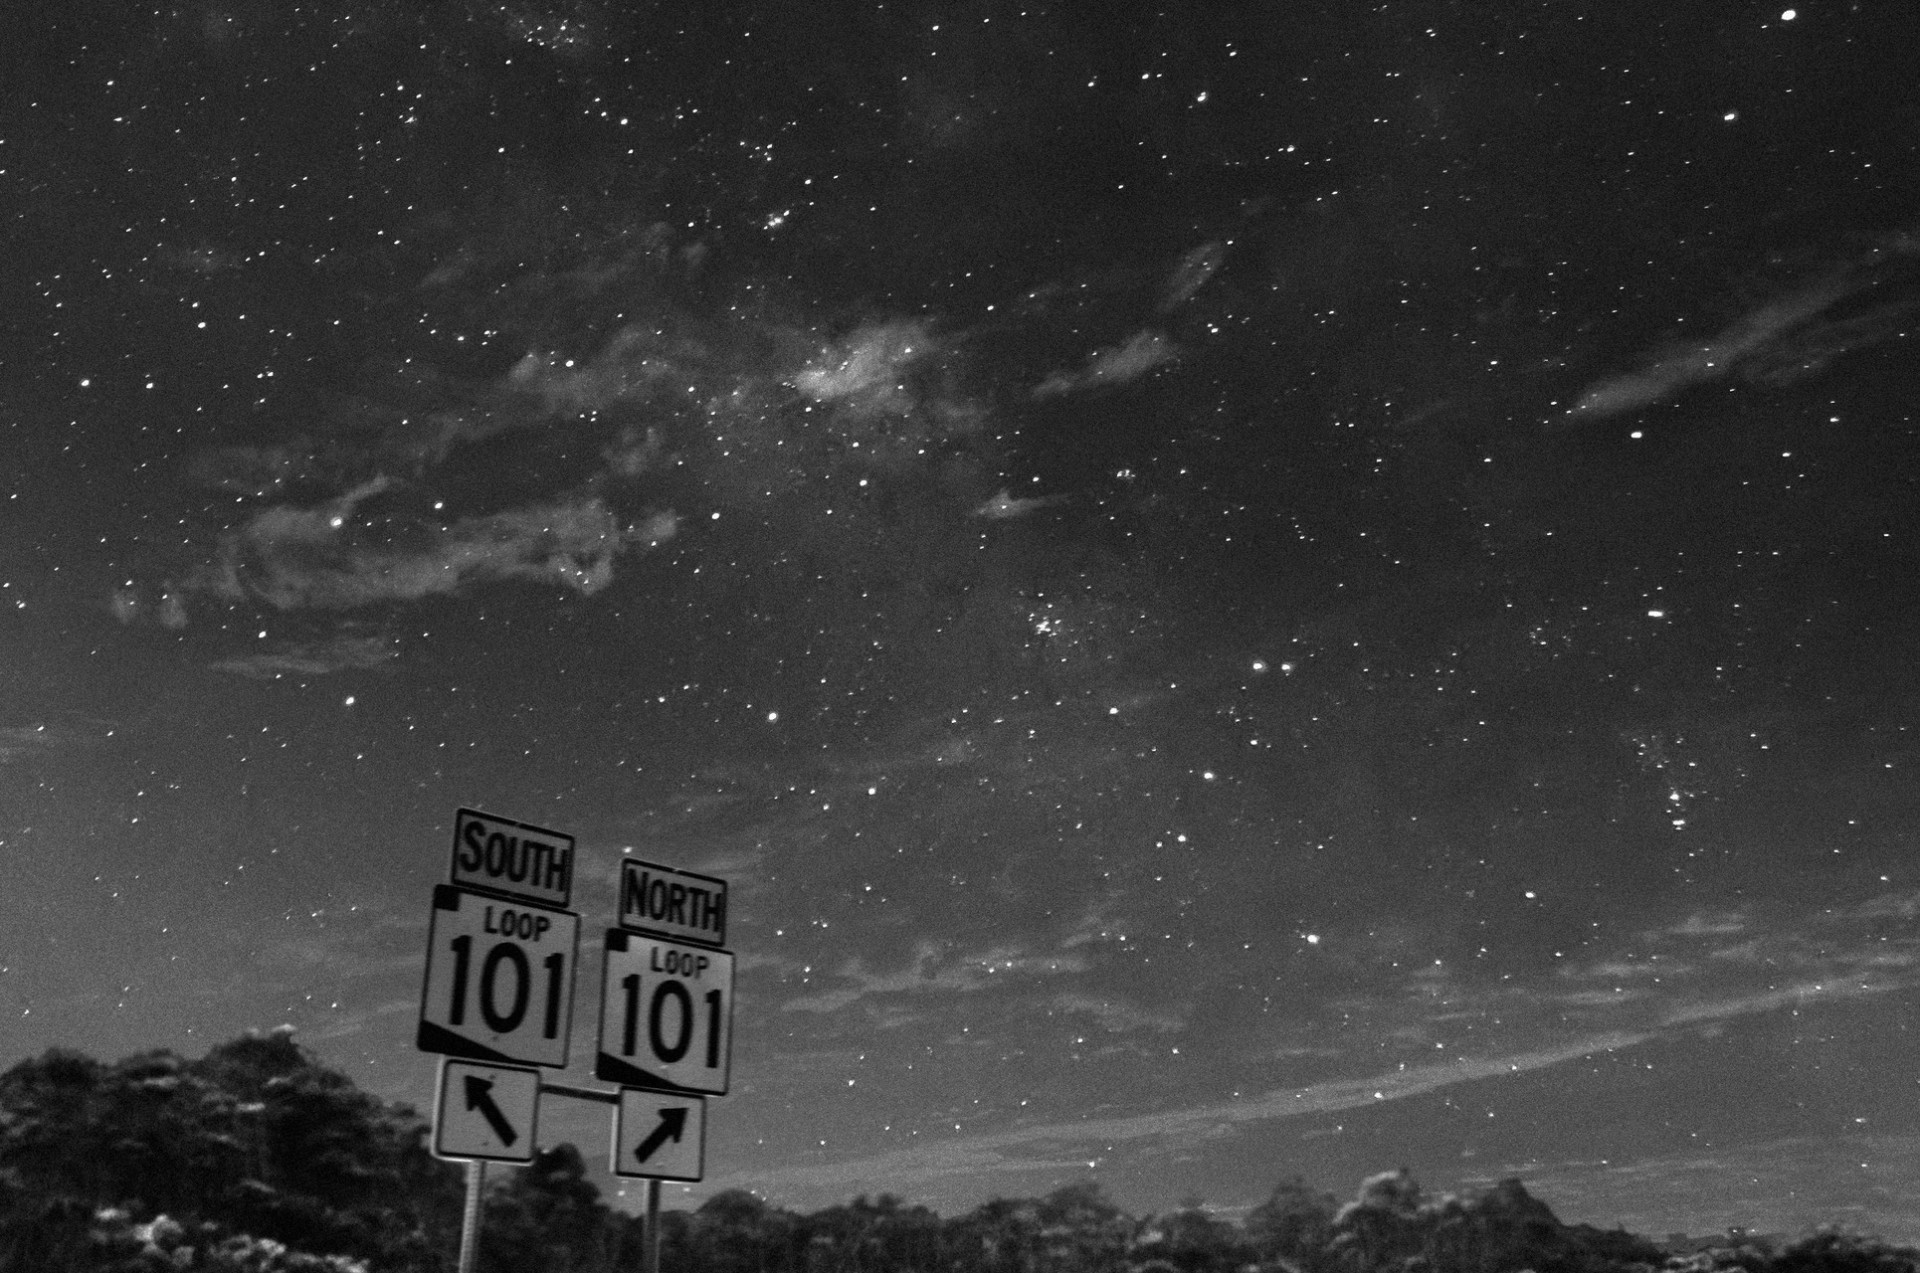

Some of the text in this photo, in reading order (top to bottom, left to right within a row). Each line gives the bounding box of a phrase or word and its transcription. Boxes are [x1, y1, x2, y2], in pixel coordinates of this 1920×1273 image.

[460, 821, 569, 892] SOUTH
[484, 906, 550, 942] LOOP
[625, 868, 723, 932] NORTH
[450, 935, 564, 1039] 101
[650, 946, 709, 979] LOOP
[621, 973, 722, 1069] 101
